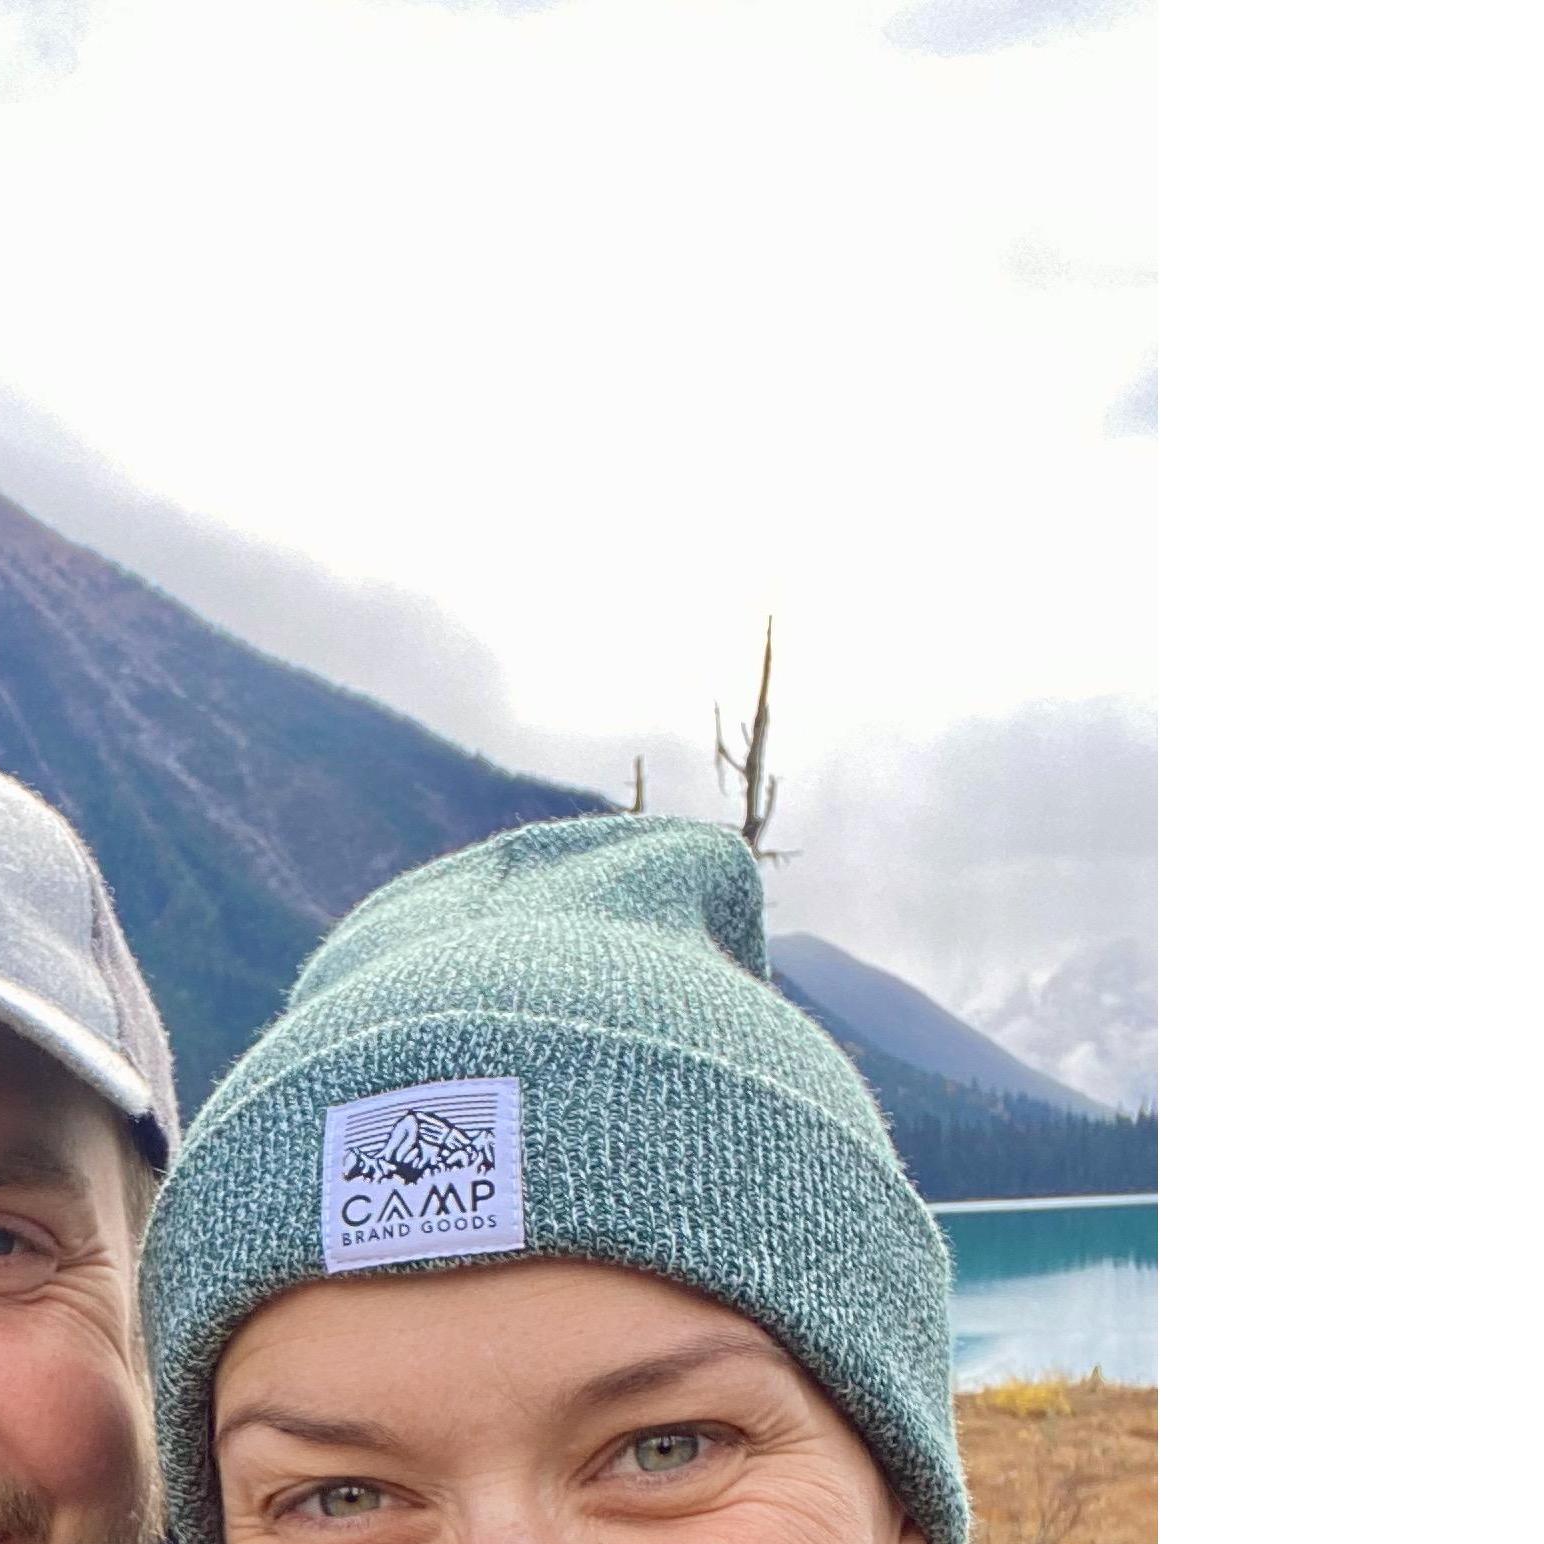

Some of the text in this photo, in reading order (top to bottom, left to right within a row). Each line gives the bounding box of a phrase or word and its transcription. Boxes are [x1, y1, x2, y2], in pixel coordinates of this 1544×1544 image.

[341, 1180, 496, 1227] CAMP
[342, 1215, 498, 1246] BRAND GOODS
